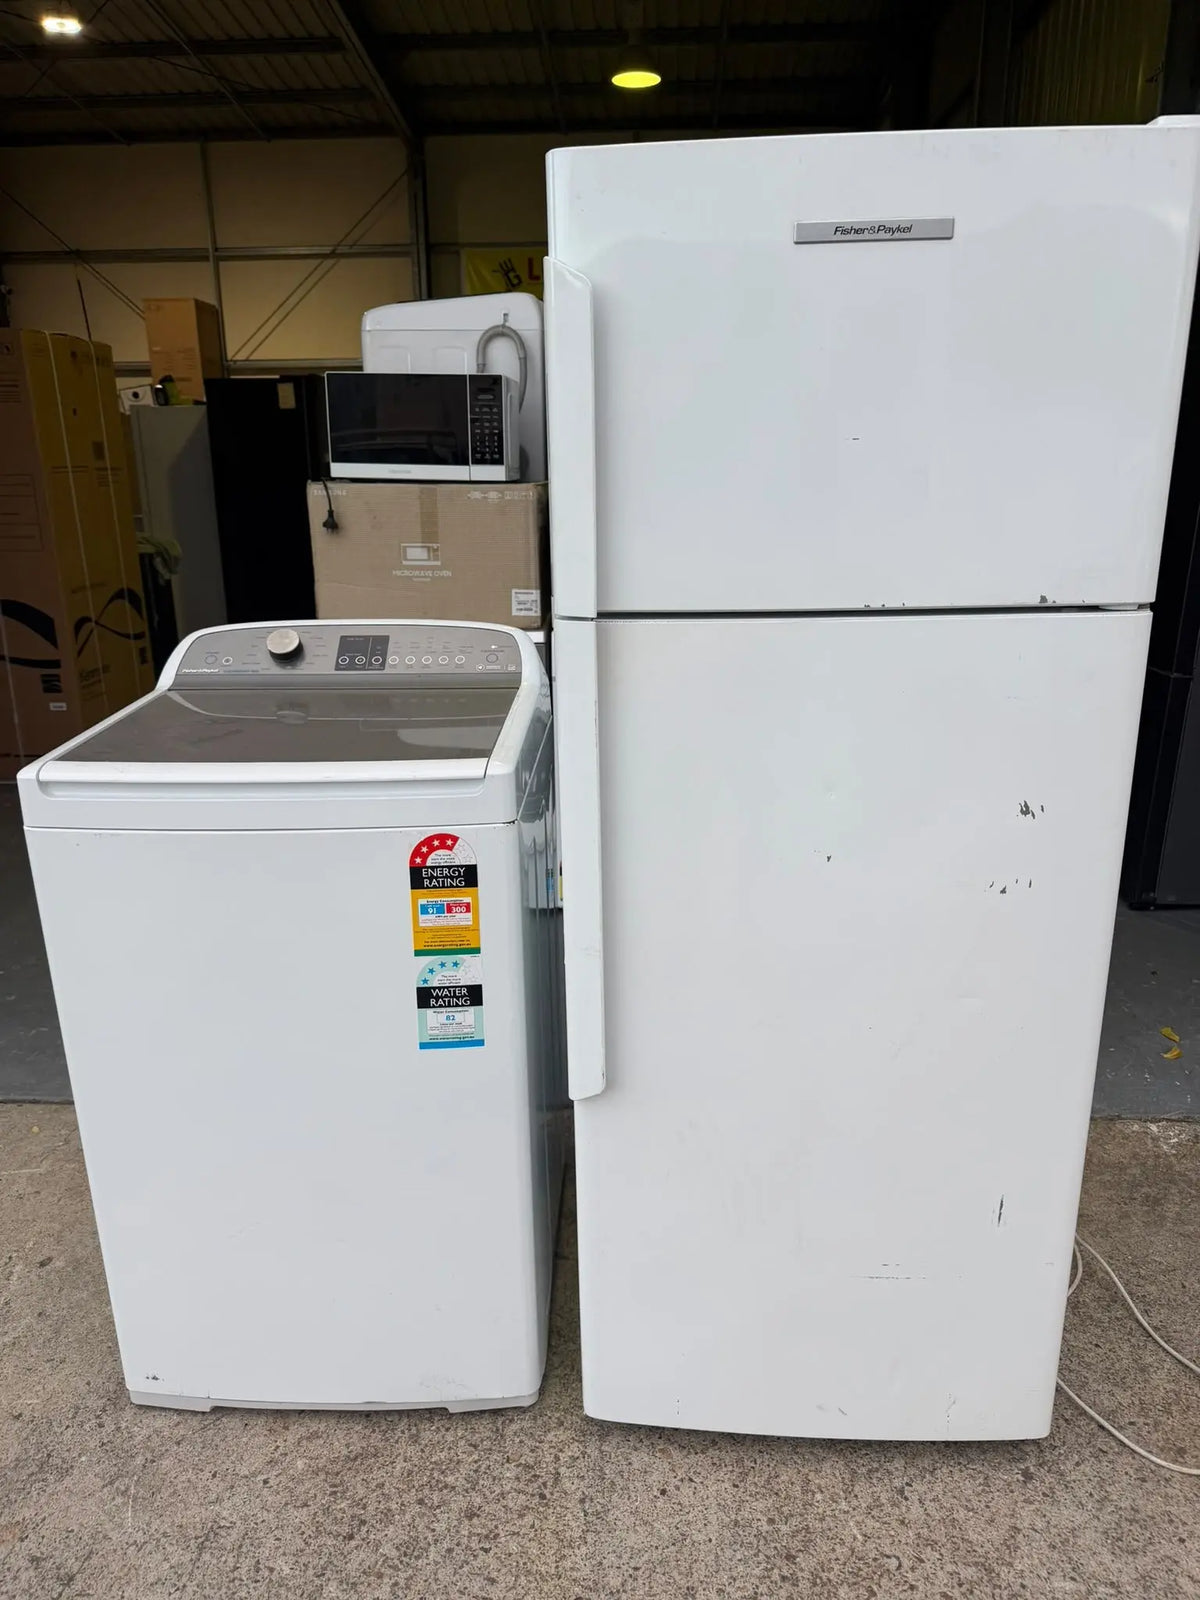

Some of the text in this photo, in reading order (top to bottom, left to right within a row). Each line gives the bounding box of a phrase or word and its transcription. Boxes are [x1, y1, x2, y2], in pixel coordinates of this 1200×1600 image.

[834, 224, 913, 237] Fisher&Paykel
[392, 569, 453, 578] MICROWAVE OVEN
[422, 867, 466, 877] ENERGY
[424, 877, 465, 887] RATING
[431, 987, 468, 996] WATER
[430, 997, 470, 1007] RATING
